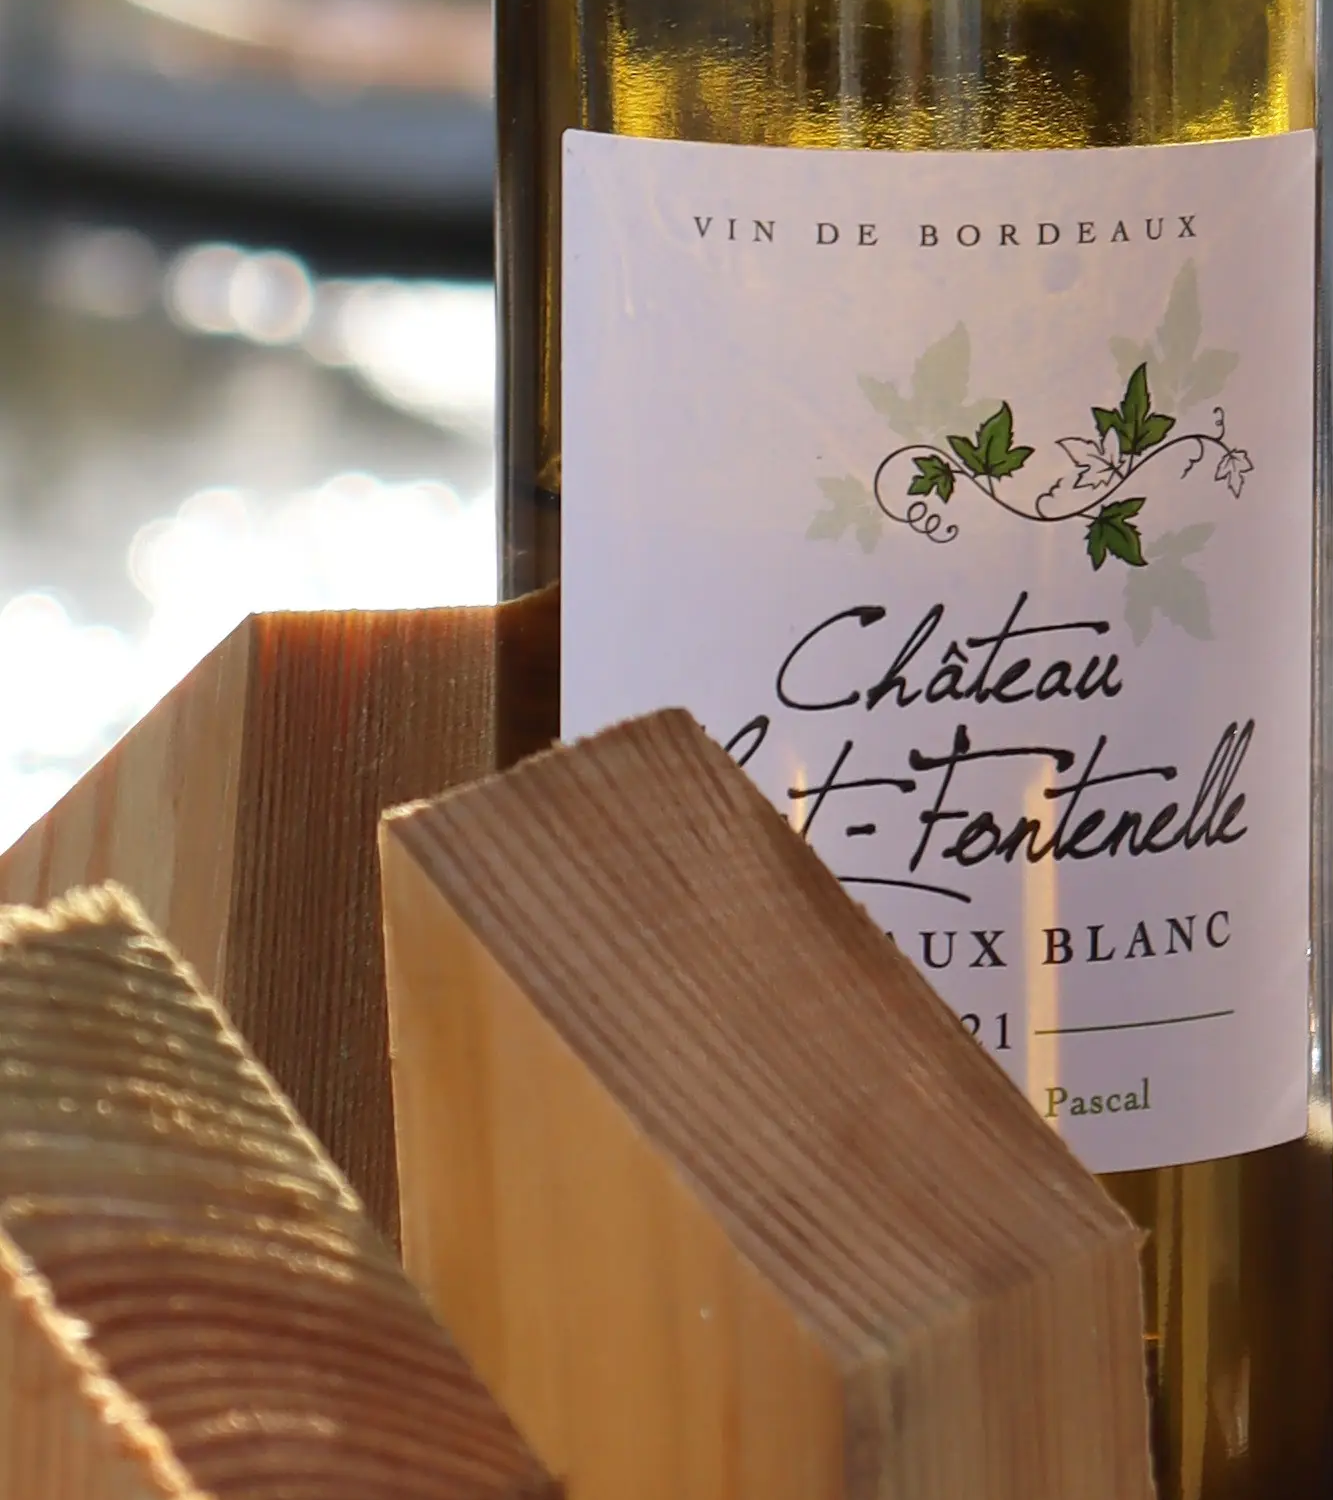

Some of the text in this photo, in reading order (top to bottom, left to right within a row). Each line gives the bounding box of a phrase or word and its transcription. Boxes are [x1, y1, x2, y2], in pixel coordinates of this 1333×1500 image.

[692, 214, 1200, 248] VIN DE BORDEAUX
[776, 591, 1123, 711] Château
[1041, 909, 1232, 966] BLANC
[1045, 1076, 1151, 1118] Pascal
